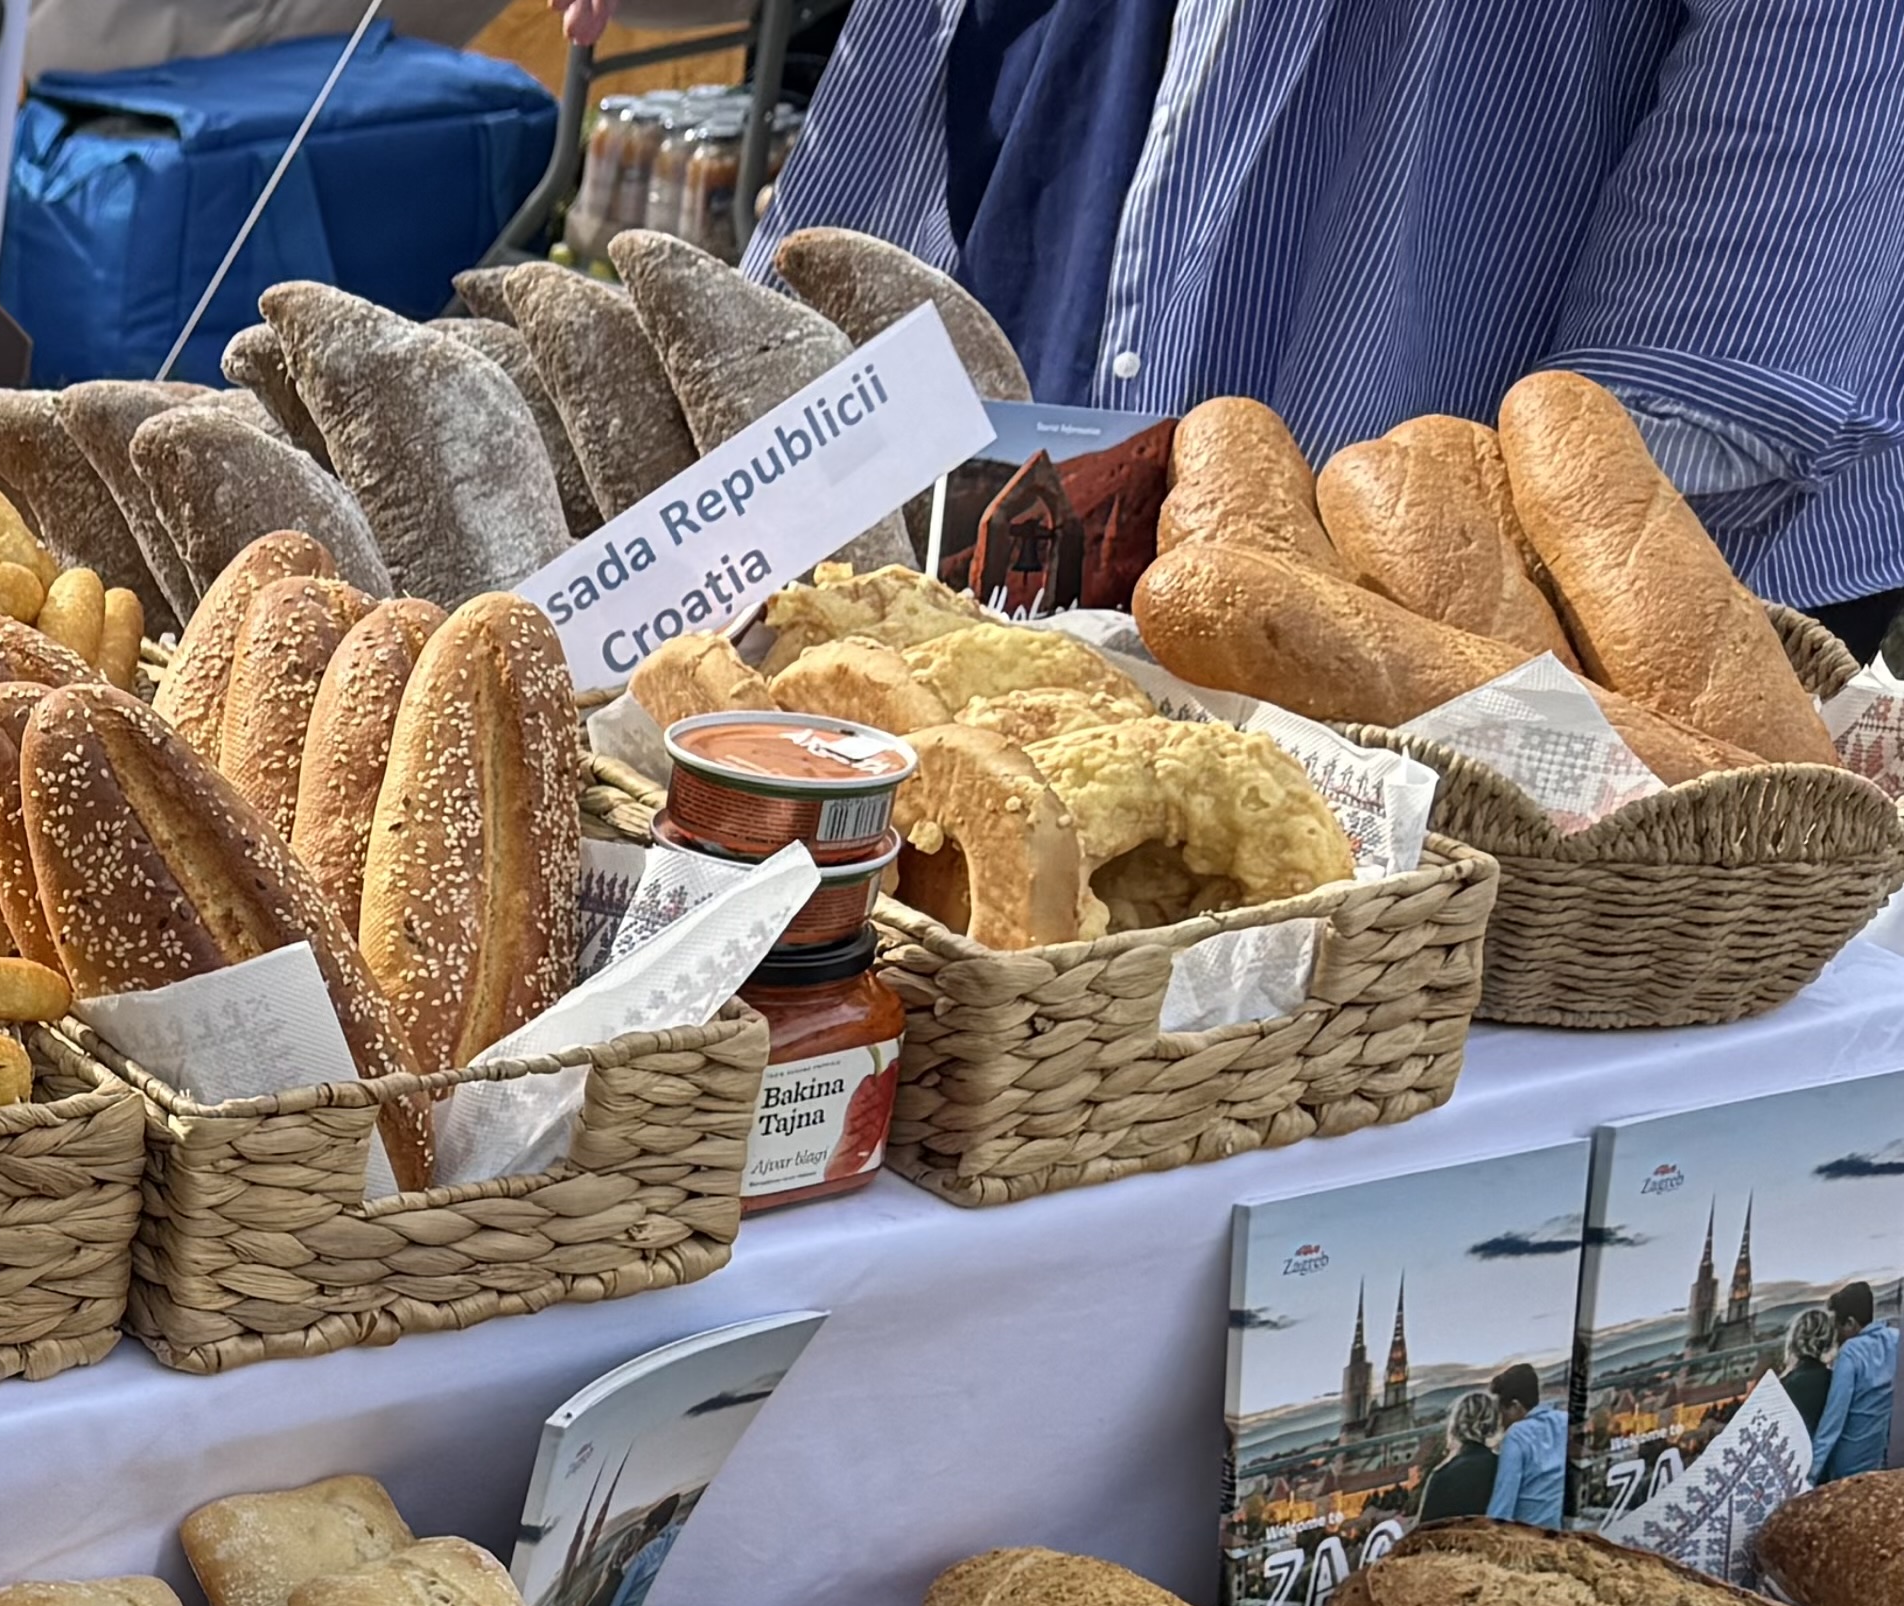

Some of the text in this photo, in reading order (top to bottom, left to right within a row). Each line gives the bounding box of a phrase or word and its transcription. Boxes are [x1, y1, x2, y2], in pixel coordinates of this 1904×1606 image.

[545, 363, 890, 627] sada Republicii
[760, 1077, 845, 1110] Bakina
[758, 1107, 826, 1137] Tajna
[1641, 1170, 1685, 1195] Zagreb
[1283, 1252, 1330, 1277] Zagreb
